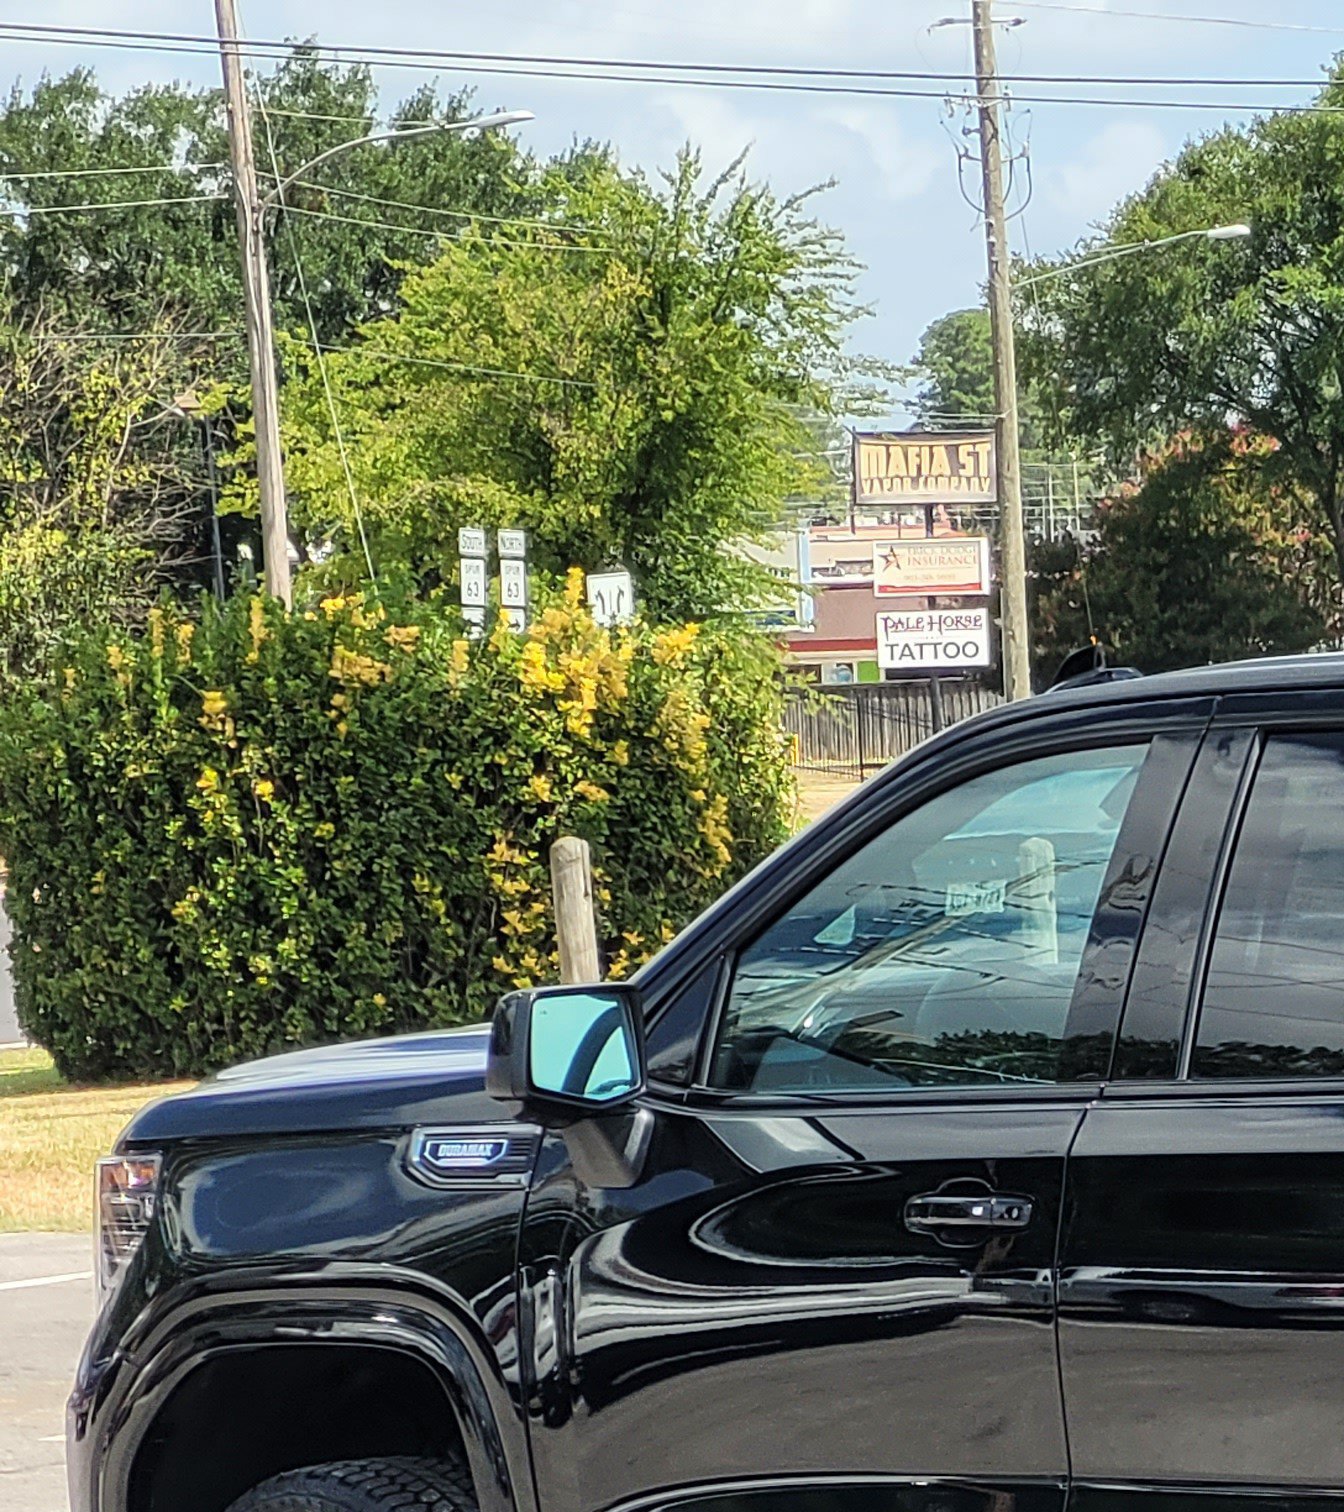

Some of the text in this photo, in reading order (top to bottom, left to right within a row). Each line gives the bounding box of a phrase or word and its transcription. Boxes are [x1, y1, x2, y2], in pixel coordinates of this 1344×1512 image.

[860, 442, 992, 478] MAFIA ST
[861, 475, 991, 496] VAPOR COMPANY
[467, 582, 479, 597] 63
[507, 582, 519, 598] 63
[881, 615, 983, 641] PALE HORSE
[885, 641, 980, 661] TATTOO
[437, 1143, 493, 1157] DURAMAX
